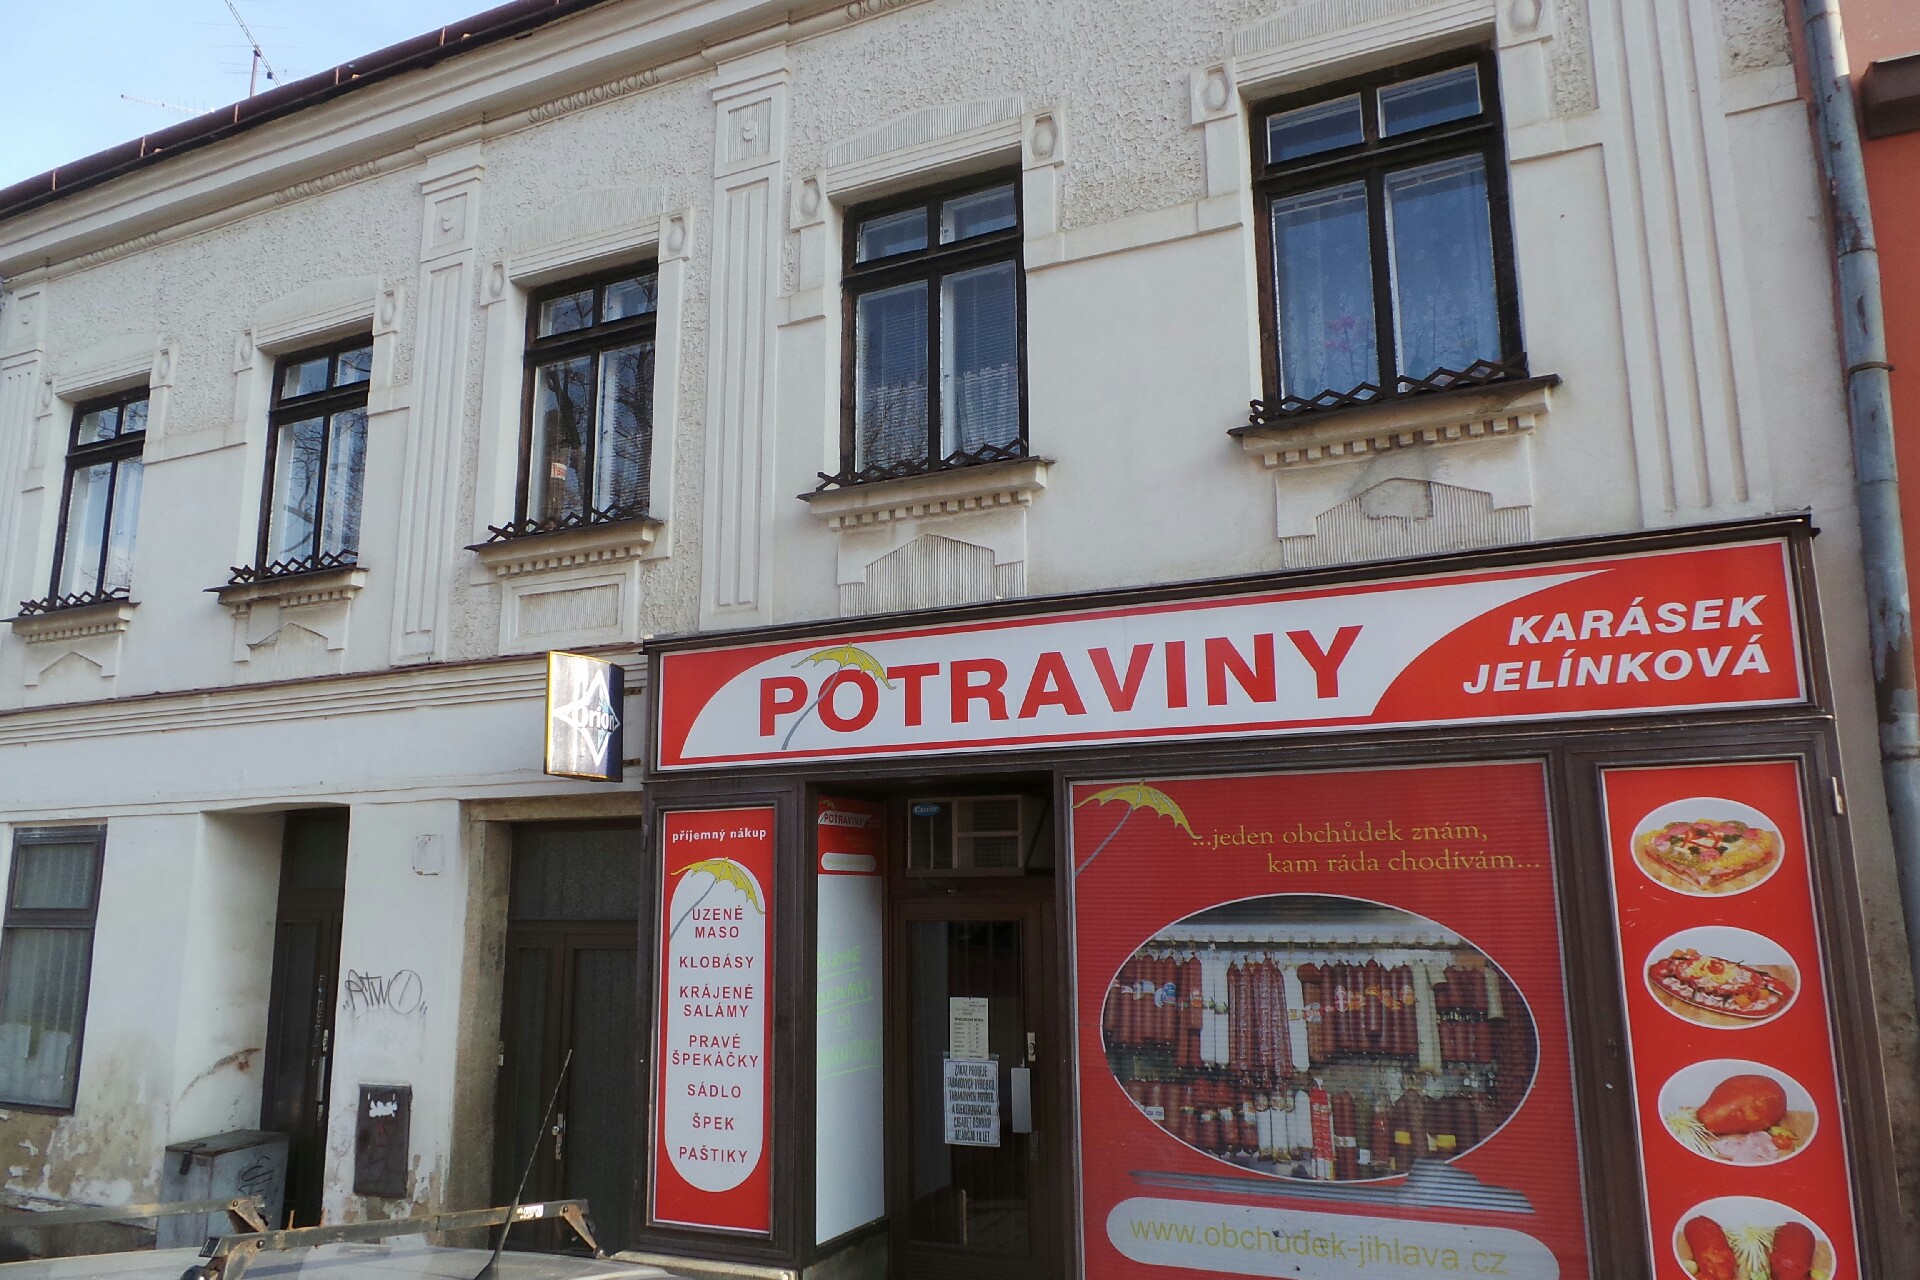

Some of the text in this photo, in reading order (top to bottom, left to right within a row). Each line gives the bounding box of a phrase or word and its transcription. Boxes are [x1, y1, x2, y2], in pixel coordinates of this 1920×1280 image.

[1508, 594, 1767, 646] KARÁSEK
[1463, 633, 1771, 694] JELÍNKOVÁ
[759, 625, 1364, 737] POTRAVINY
[576, 704, 615, 733] Orion
[914, 805, 940, 814] Carrier
[823, 813, 864, 826] POTRAVINY
[672, 827, 767, 844] příjemný nákup
[1282, 820, 1403, 844] obchůdek
[1412, 821, 1489, 843] znám,
[1267, 850, 1541, 873] kam ráda chodívám...
[692, 904, 743, 921] UZENÉ
[695, 926, 739, 939] MASO
[679, 953, 754, 969] KLOBÁSY
[679, 983, 754, 1000] KRÁJENÉ
[683, 1002, 749, 1018] SALÁMY
[689, 1033, 741, 1049] PRAVÉ
[671, 1049, 759, 1068] ŠPEKÁČKY
[687, 1081, 742, 1098] SÁDLO
[692, 1112, 735, 1131] ŠPEK
[679, 1145, 748, 1163] PAŠTIKY
[1129, 1217, 1509, 1275] www.obchudek-jihlava.cz
